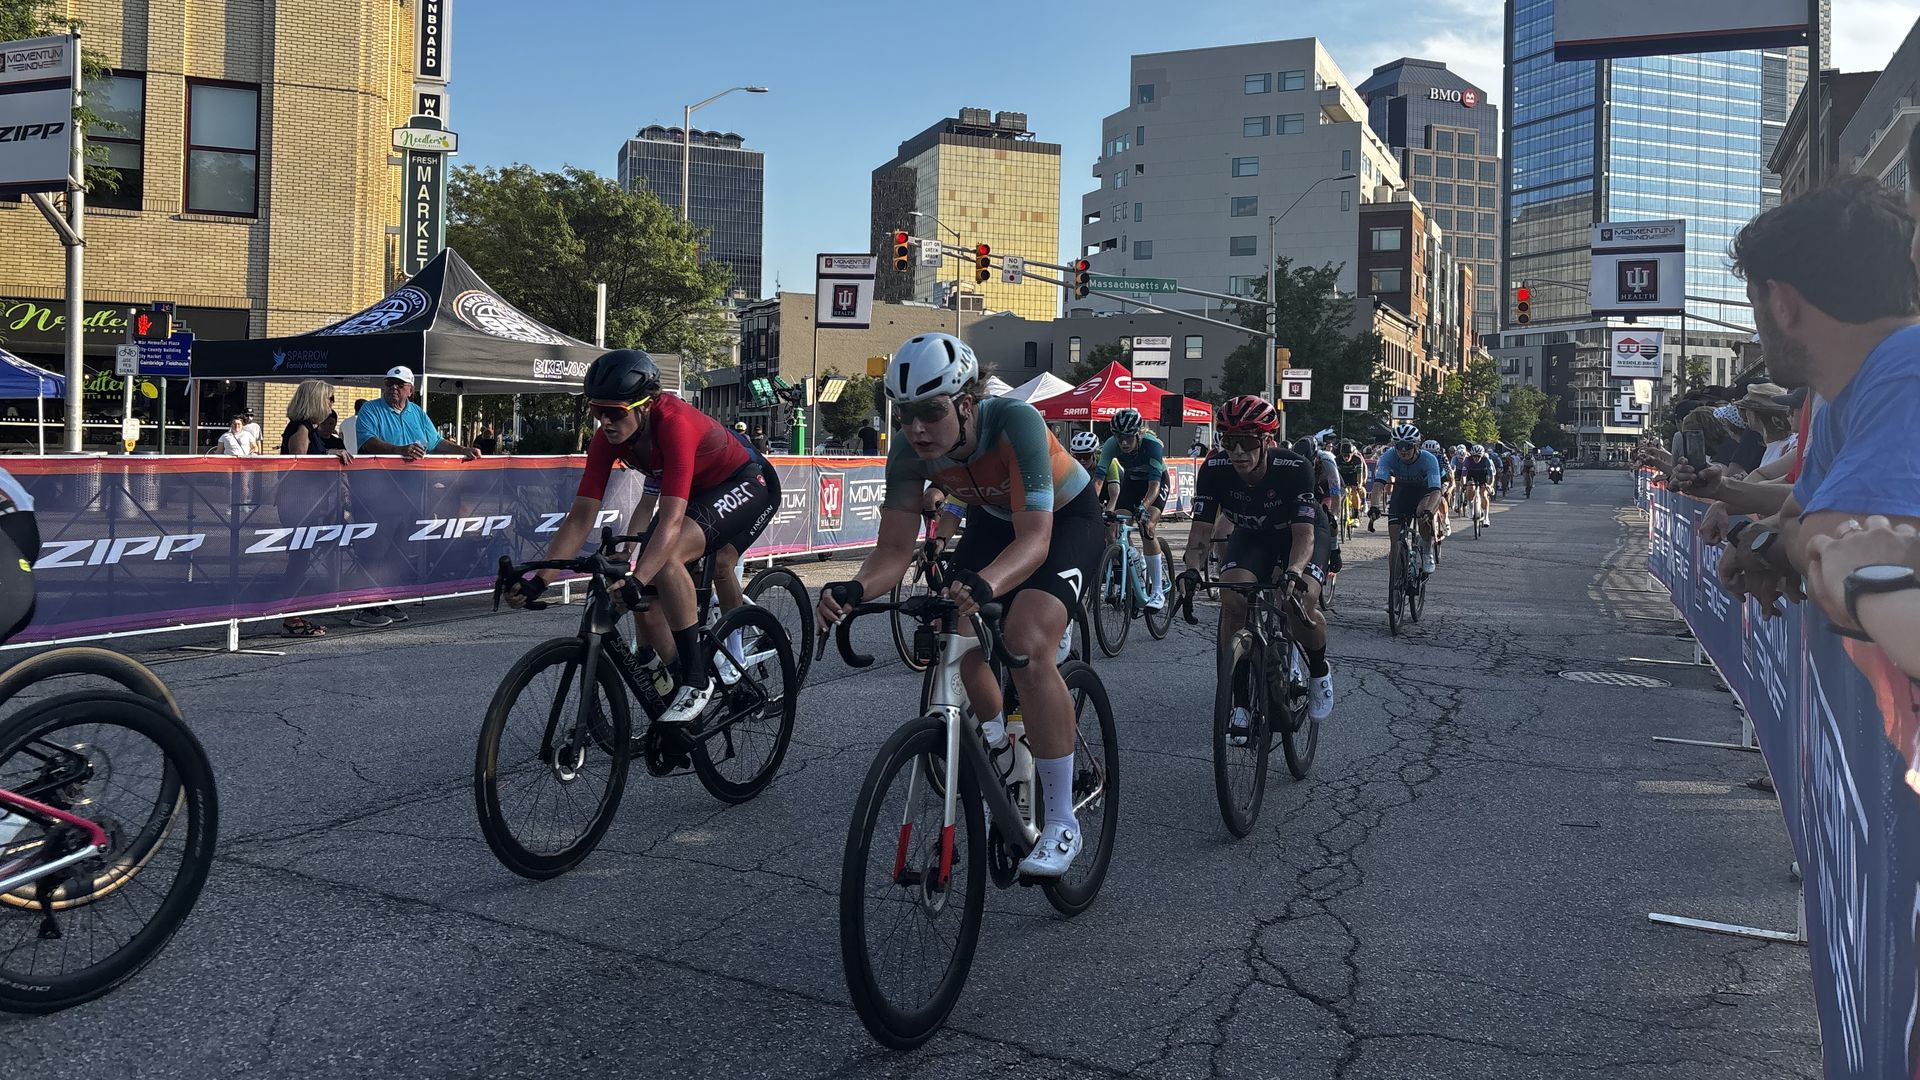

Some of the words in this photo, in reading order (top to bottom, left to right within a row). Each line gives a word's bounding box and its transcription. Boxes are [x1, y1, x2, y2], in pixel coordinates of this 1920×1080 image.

[426, 0, 437, 67] NBOARD
[7, 49, 63, 63] MOMENTUM
[24, 62, 44, 71] INDY
[1430, 87, 1461, 102] BMO
[0, 122, 65, 142] ZIPP
[412, 156, 438, 165] FRESH
[416, 166, 431, 271] MARKET
[1614, 227, 1676, 235] MOMENTUM
[1089, 279, 1159, 290] Massachusetts
[1162, 282, 1175, 290] Av
[286, 350, 329, 361] SPARROW
[286, 362, 303, 370] Family
[1063, 407, 1089, 416] SRAM
[1272, 457, 1304, 467] BMC
[534, 509, 620, 533] ZP
[749, 504, 774, 536] KINGDOM
[408, 515, 512, 541] ZIPP
[245, 522, 378, 554] ZIPP
[32, 533, 206, 570] ZIPP
